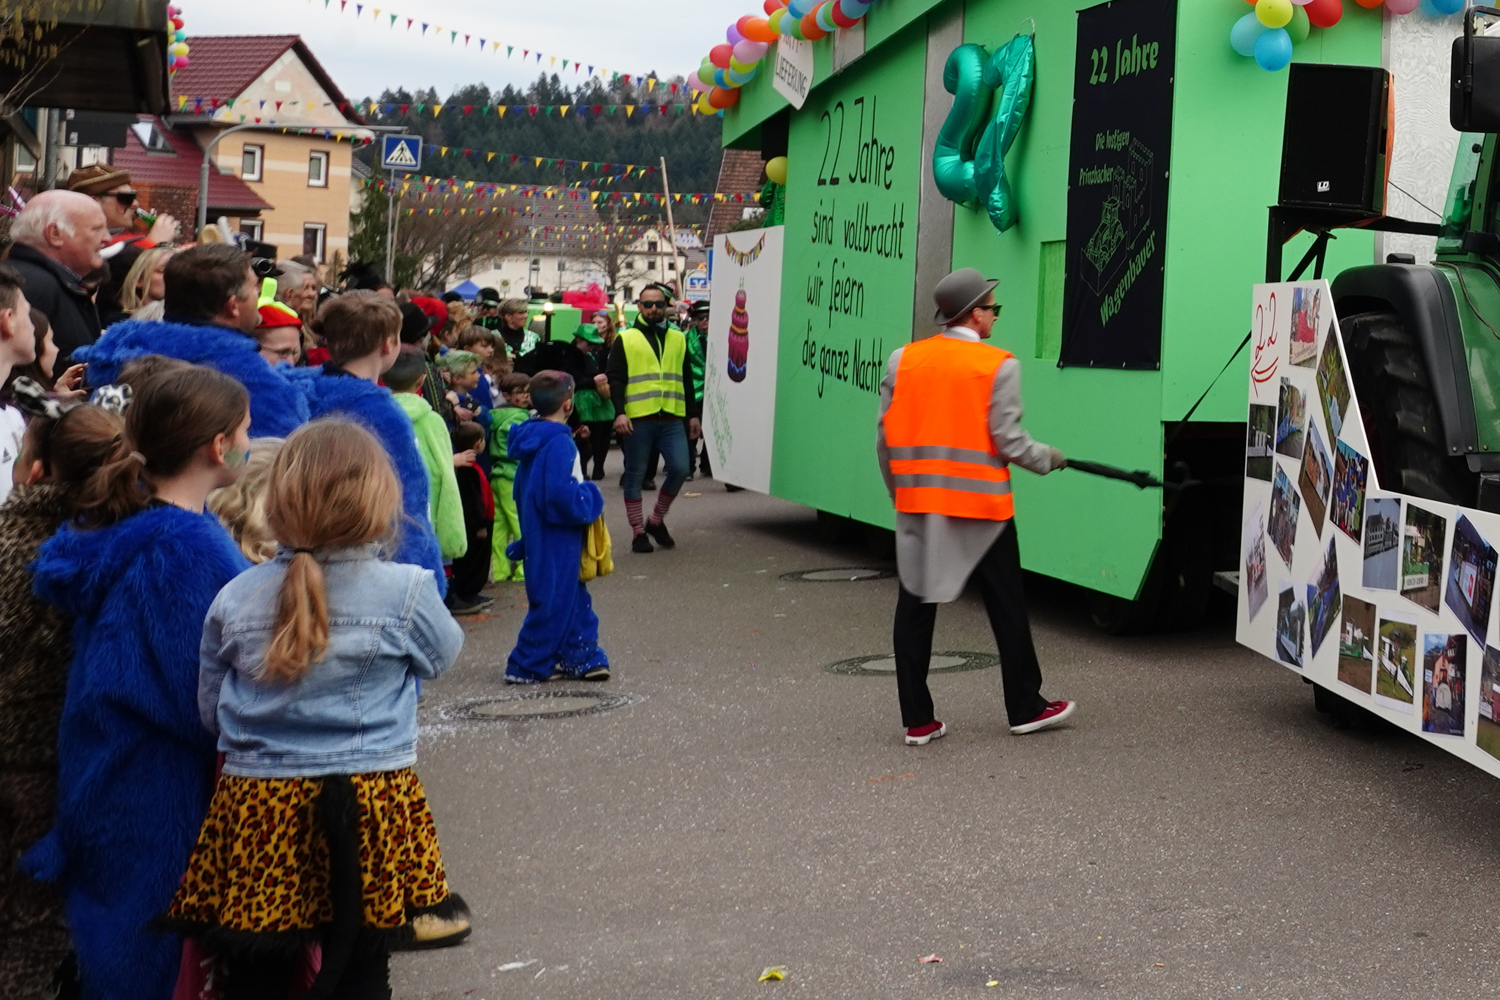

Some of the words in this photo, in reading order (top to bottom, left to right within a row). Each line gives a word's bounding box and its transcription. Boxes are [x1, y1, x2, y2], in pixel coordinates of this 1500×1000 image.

[1089, 46, 1109, 85] 22
[1113, 33, 1160, 83] Jahre
[817, 101, 845, 187] 22
[847, 95, 896, 190] Jahre
[1095, 132, 1106, 152] Die
[1106, 129, 1131, 152] lustigen
[1079, 164, 1113, 188] Prinzbacher
[810, 199, 834, 247] sind
[844, 203, 905, 260] vollbracht
[806, 263, 824, 308] wir
[829, 258, 865, 329] feiern
[1099, 229, 1156, 329] Wagenbauer
[802, 324, 816, 369] die
[818, 338, 849, 399] ganze
[853, 336, 884, 396] Nacht
